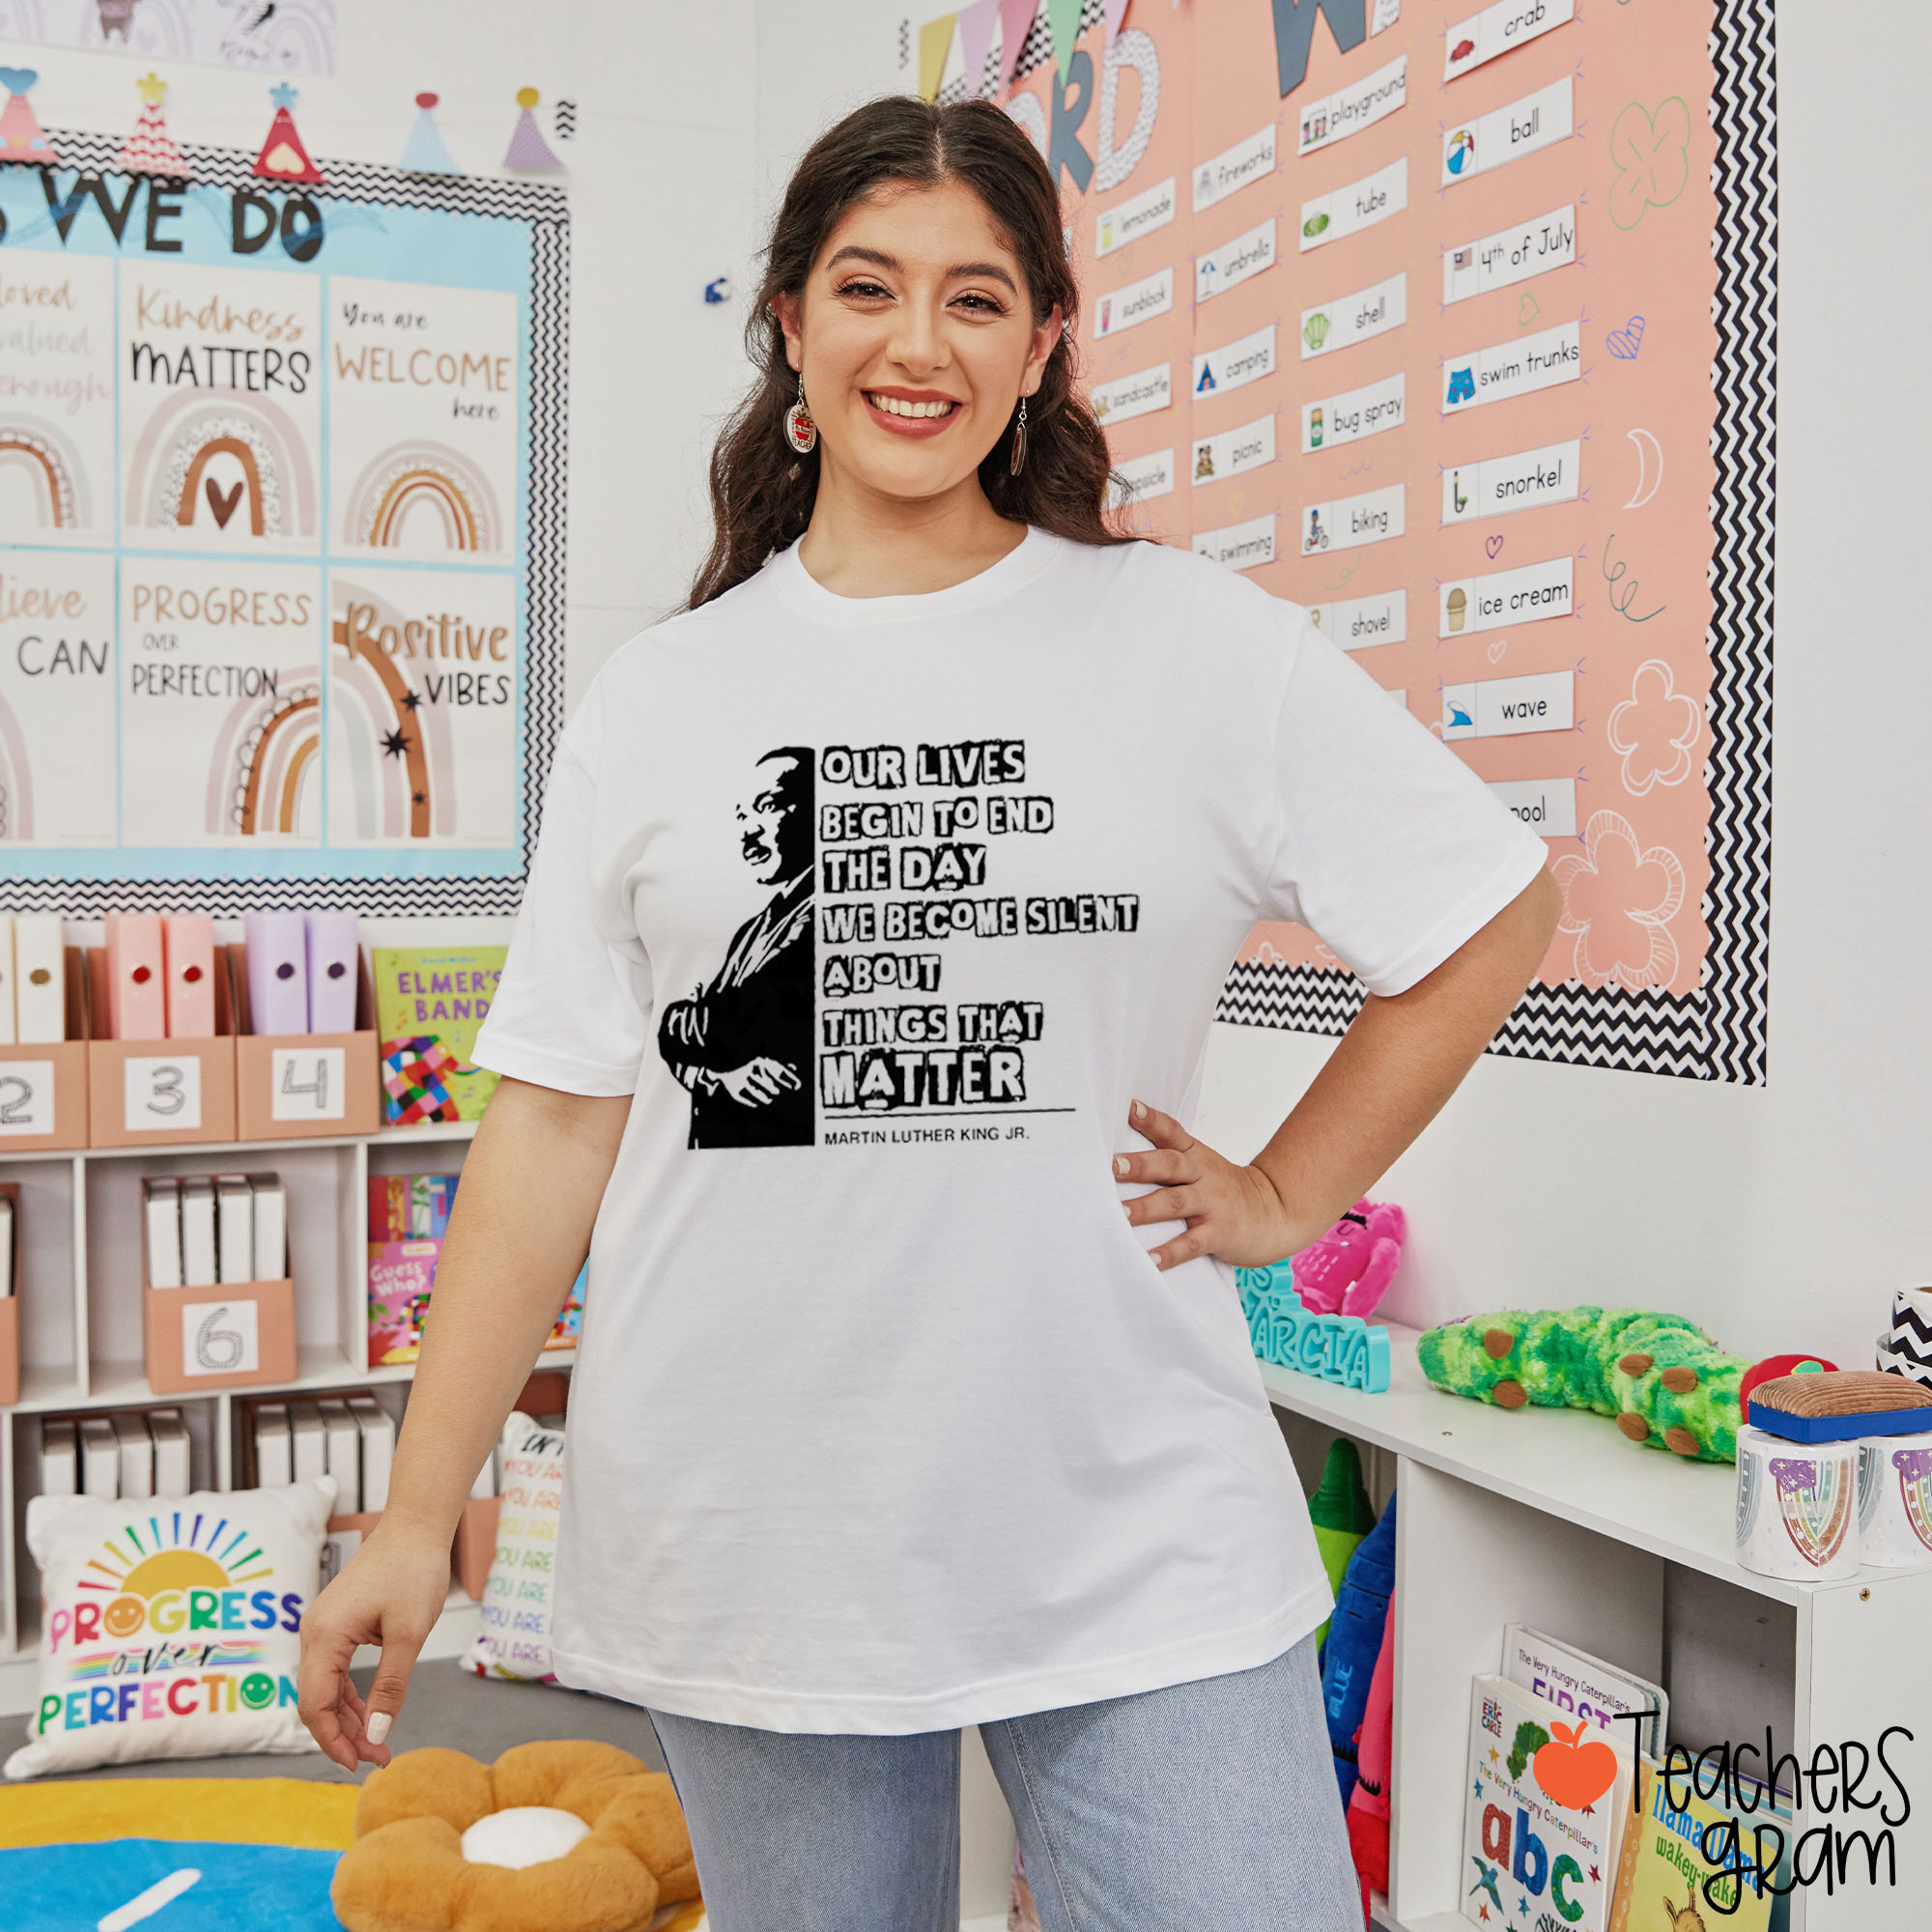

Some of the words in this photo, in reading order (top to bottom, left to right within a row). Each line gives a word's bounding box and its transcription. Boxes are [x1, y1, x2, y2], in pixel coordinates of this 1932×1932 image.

[1504, 0, 1546, 37] crab
[1331, 64, 1407, 131] playground
[1511, 106, 1540, 144] ball
[1217, 141, 1273, 184] fireworks
[39, 171, 187, 252] WE
[232, 187, 324, 263] DO
[1121, 194, 1172, 233] lemonade
[1355, 187, 1387, 217] tube
[1223, 238, 1270, 277] umbrella
[1482, 242, 1505, 274] 4th
[1511, 235, 1531, 266] of
[1538, 222, 1574, 255] July
[137, 284, 306, 342] Kindness
[343, 301, 385, 327] You
[395, 312, 429, 329] are
[1122, 285, 1167, 319] sunblock
[1355, 296, 1385, 329] shell
[335, 341, 511, 392] WELCOME
[1226, 348, 1268, 378] camping
[1480, 363, 1520, 386] swim
[1526, 340, 1579, 373] trunks
[453, 396, 499, 419] here
[1113, 374, 1169, 408] sandcastle
[1334, 410, 1360, 434] bug
[1364, 396, 1403, 427] spray
[1232, 440, 1263, 468] picnic
[1495, 459, 1562, 499] snorkel
[1351, 507, 1388, 533] biking
[1220, 535, 1272, 562] swimming
[132, 584, 312, 626] PROGRESS
[1479, 596, 1502, 617] ice
[1510, 582, 1569, 611] cream
[347, 602, 508, 662] Positive
[1351, 607, 1391, 637] shovel
[17, 635, 109, 675] CAN
[144, 633, 179, 651] OVER
[131, 664, 278, 697] PERFECTION
[425, 672, 511, 706] VIBES
[1501, 698, 1547, 720] wave
[821, 745, 905, 788] OUR
[917, 740, 1025, 785] LIVES
[820, 802, 923, 840] BEGIN
[933, 796, 978, 838] TO
[987, 796, 1053, 834] END
[823, 845, 890, 893] THE
[900, 842, 986, 891] DAY
[822, 903, 874, 942] WE
[884, 897, 1017, 939] BECOME
[1026, 895, 1138, 934] SILENT
[824, 953, 940, 998] ABOUT
[414, 999, 492, 1023] BAND
[823, 1006, 947, 1046] THINGS
[958, 1002, 1043, 1043] THAT
[147, 1065, 185, 1116] 3
[282, 1058, 327, 1109] 4
[820, 1044, 1026, 1109] MATTER
[825, 1131, 886, 1146] MARTIN
[892, 1128, 954, 1144] LUTHER
[961, 1126, 999, 1142] KING
[1006, 1125, 1030, 1141] JR.
[370, 1262, 423, 1283] Guess
[374, 1273, 428, 1297] Who?
[196, 1305, 244, 1370] 6
[522, 1548, 554, 1573] ARE
[517, 1580, 548, 1604] ARE
[50, 1591, 302, 1655] PROGRESS
[513, 1610, 545, 1634] ARE
[111, 1641, 228, 1676] over
[512, 1641, 544, 1662] ARE
[1328, 1660, 1353, 1719] BLUE
[1519, 1648, 1531, 1665] The
[1533, 1655, 1549, 1677] Very
[1551, 1665, 1578, 1691] Hungry
[1581, 1681, 1631, 1714] Caterpillar's
[39, 1672, 298, 1735] PERFECTION
[1483, 1701, 1502, 1724] ERIC
[1482, 1715, 1501, 1739] CARLE
[1480, 1761, 1492, 1779] The
[1494, 1773, 1512, 1797] Very
[1514, 1786, 1542, 1819] Hungry
[1544, 1808, 1598, 1855] Caterpillar's
[1482, 1804, 1584, 1922] abc
